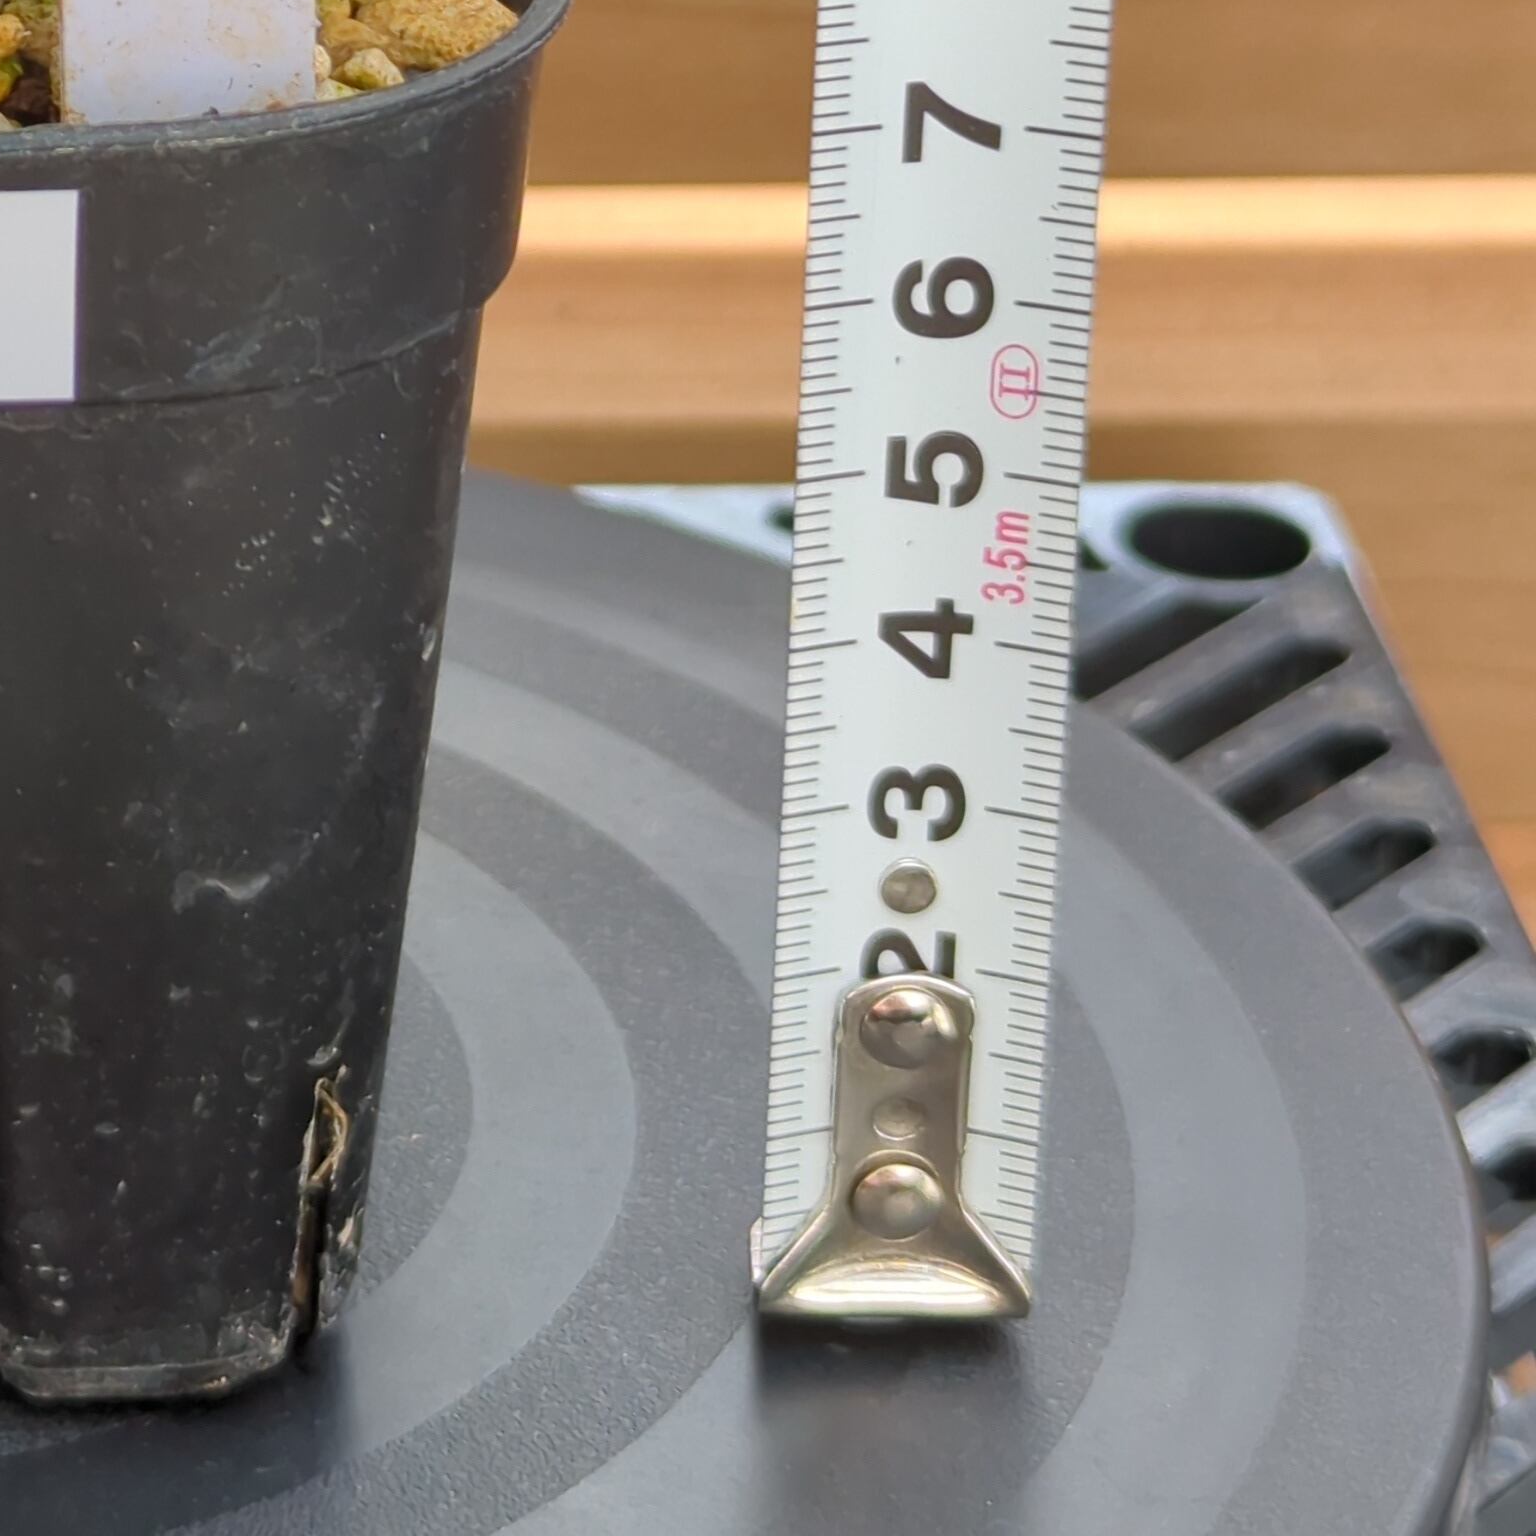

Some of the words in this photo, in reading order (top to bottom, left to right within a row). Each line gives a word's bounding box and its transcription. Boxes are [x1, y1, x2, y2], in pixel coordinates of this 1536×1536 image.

[901, 80, 1003, 164] 7
[891, 256, 996, 339] 6
[884, 430, 985, 508] 5
[981, 510, 1031, 605] 3.5m
[877, 597, 974, 680] 4
[866, 763, 966, 842] 3
[859, 927, 957, 980] 2
